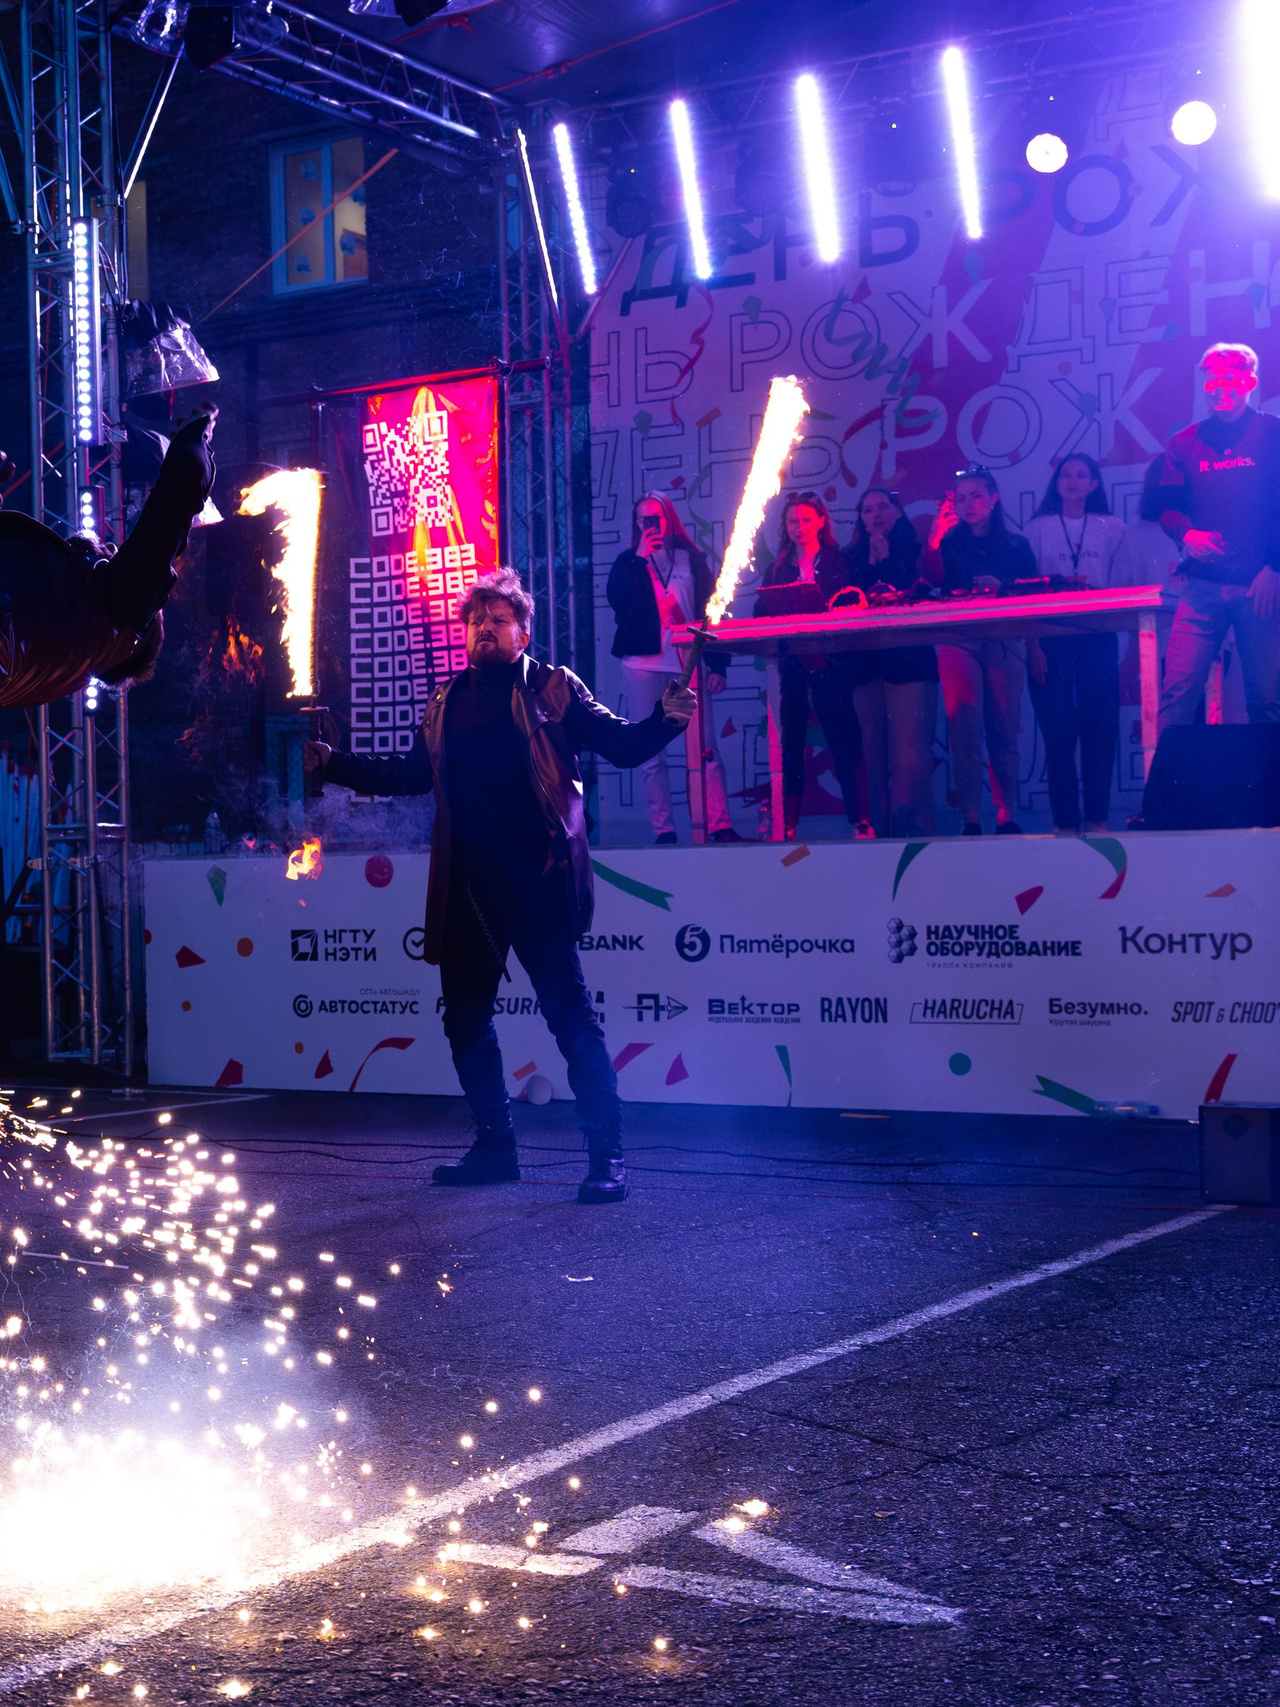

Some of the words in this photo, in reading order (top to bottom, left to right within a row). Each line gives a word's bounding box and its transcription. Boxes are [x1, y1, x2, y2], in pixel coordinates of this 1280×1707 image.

[350, 543, 476, 578] CODE.383
[351, 730, 416, 753] COD
[324, 928, 376, 944] НГТУ
[926, 925, 1019, 940] НАУЧНОЕ
[1118, 925, 1253, 960] Контур
[324, 946, 377, 962] НЭТИ
[720, 934, 855, 958] Пятёрочка
[926, 940, 1082, 958] ОБОРУДОВАНИЕ
[318, 1000, 420, 1015] АВТОСТАТУС
[821, 997, 888, 1023] RAYON
[923, 999, 1015, 1020] HARUCHA
[1049, 997, 1149, 1018] Безумно.
[1171, 1001, 1216, 1024] SPOT
